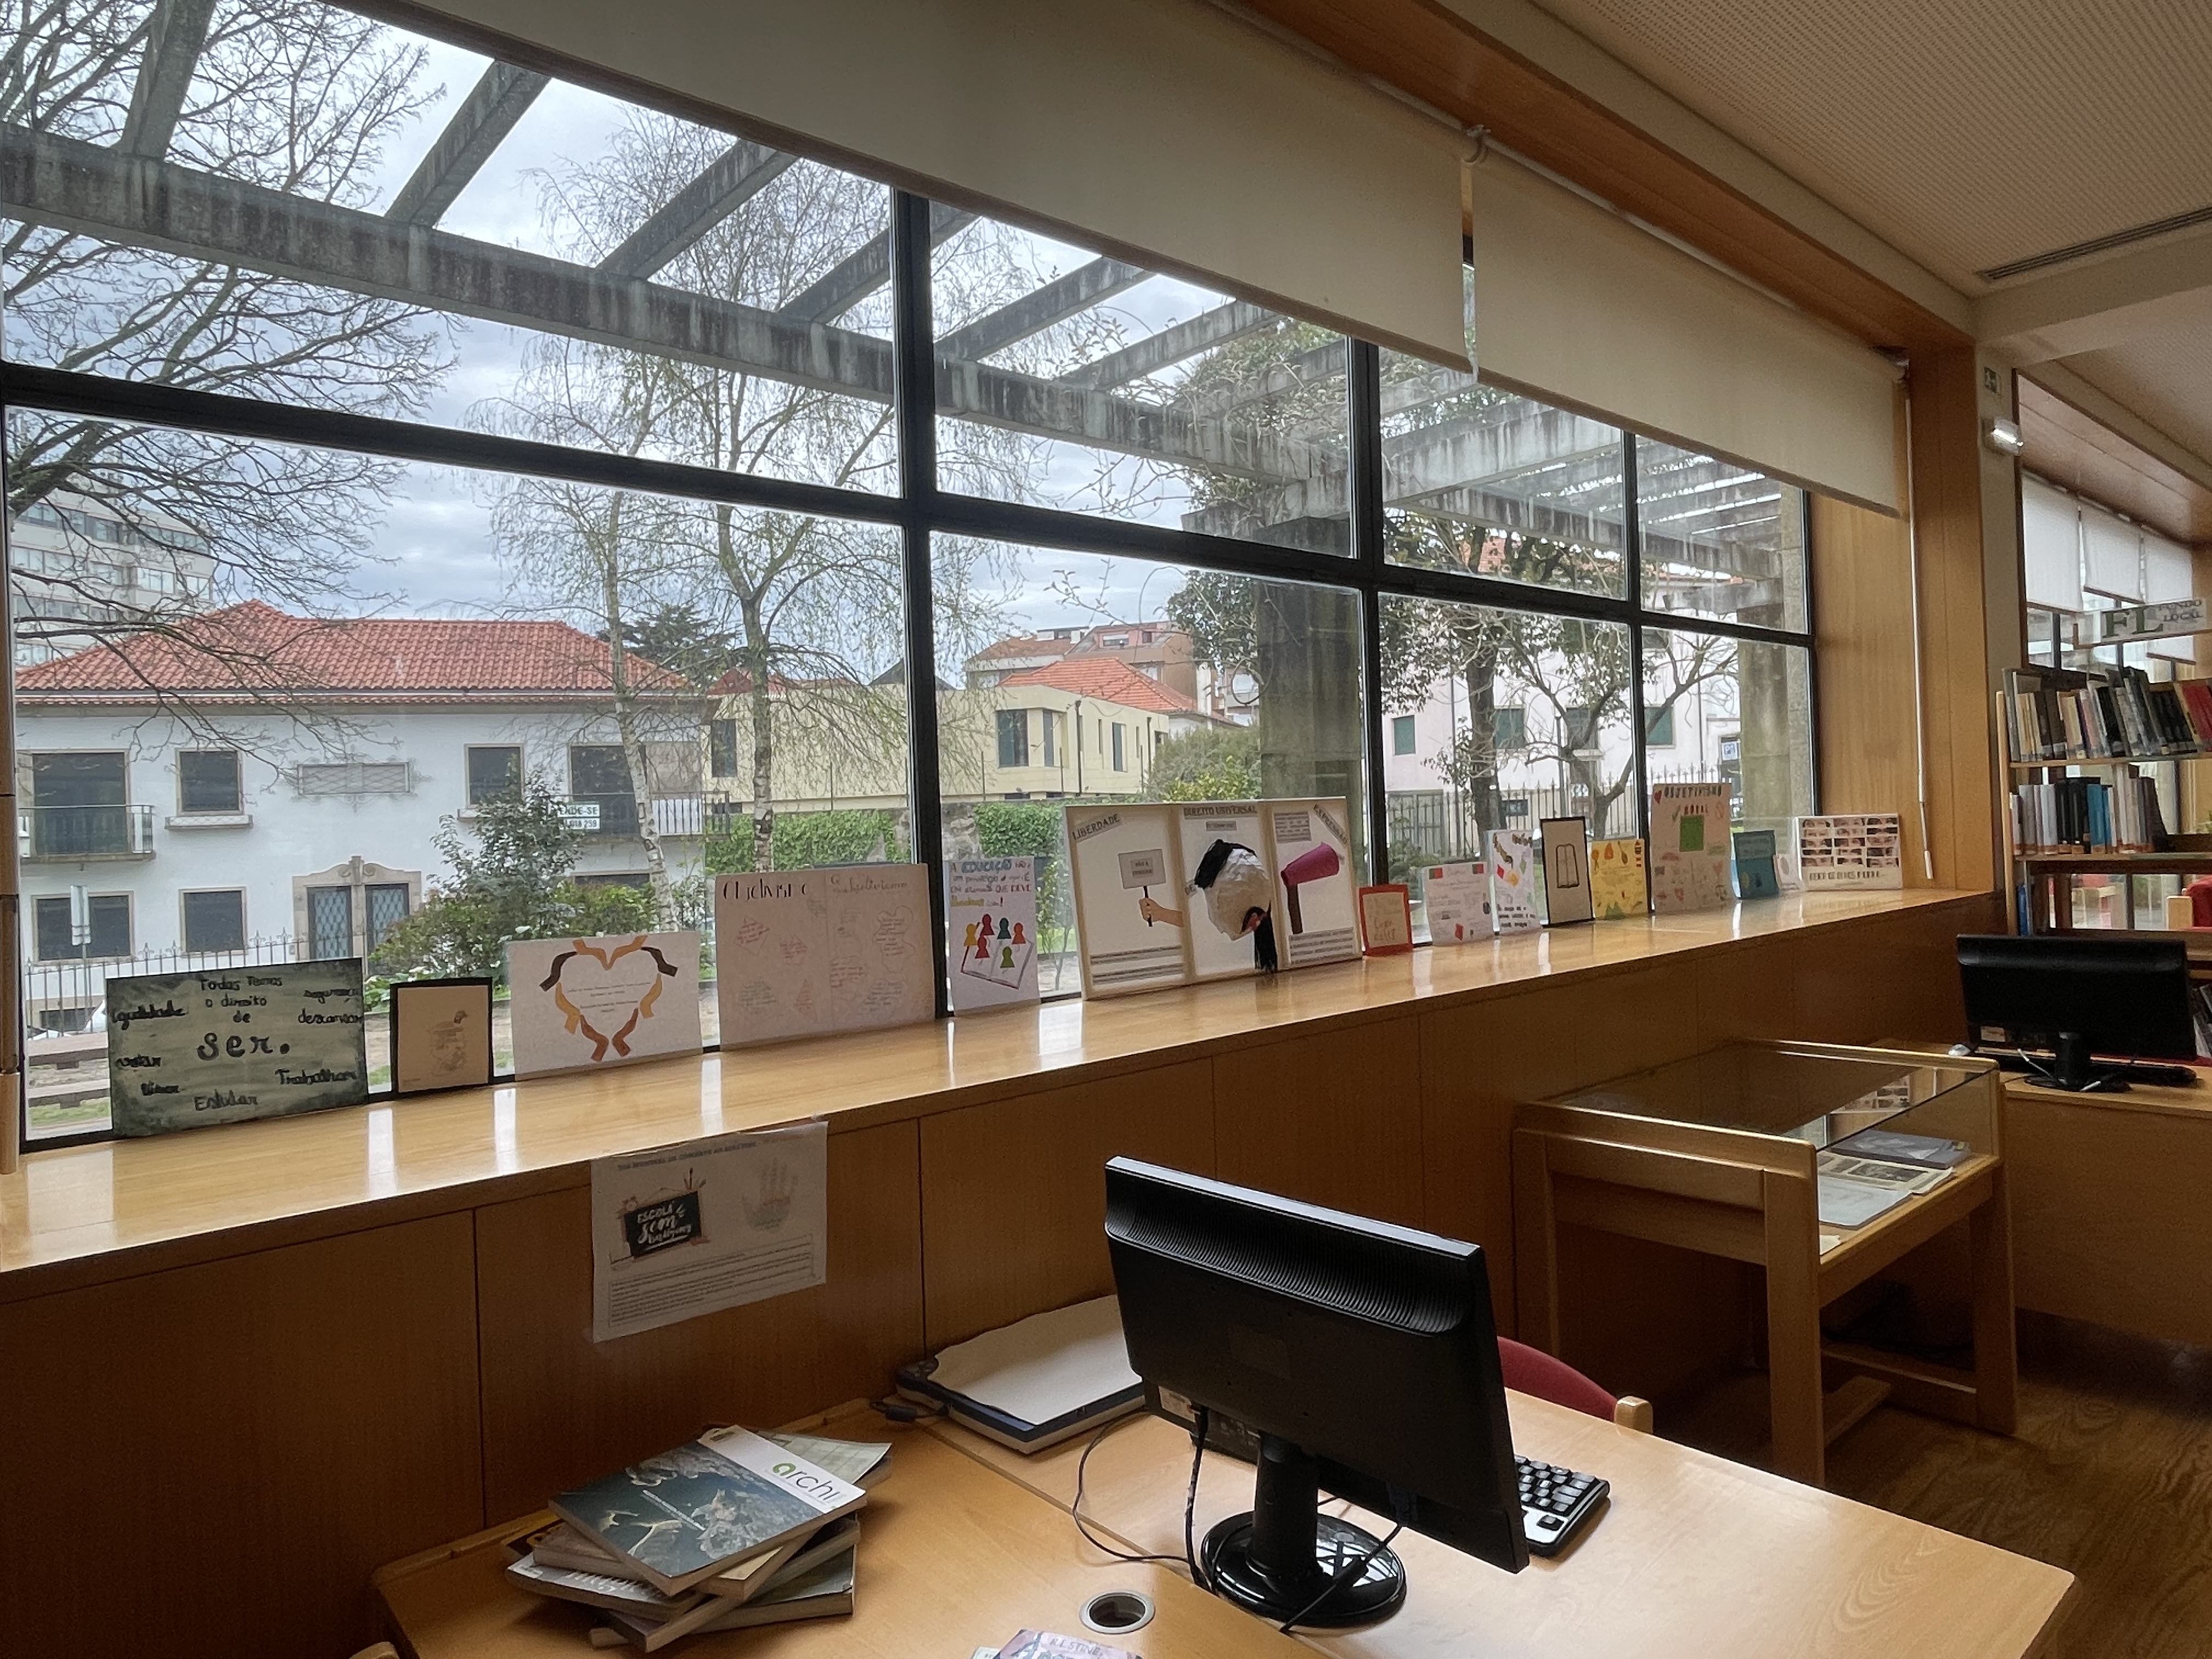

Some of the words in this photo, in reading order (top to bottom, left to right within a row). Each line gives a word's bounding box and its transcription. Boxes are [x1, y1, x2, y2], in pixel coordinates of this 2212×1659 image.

[2103, 607, 2164, 638] FL
[1183, 806, 1215, 816] DIREITO
[1216, 805, 1257, 815] UNIVERSAL
[1072, 813, 1120, 840] LIBERDADE
[772, 1462, 840, 1501] archi
